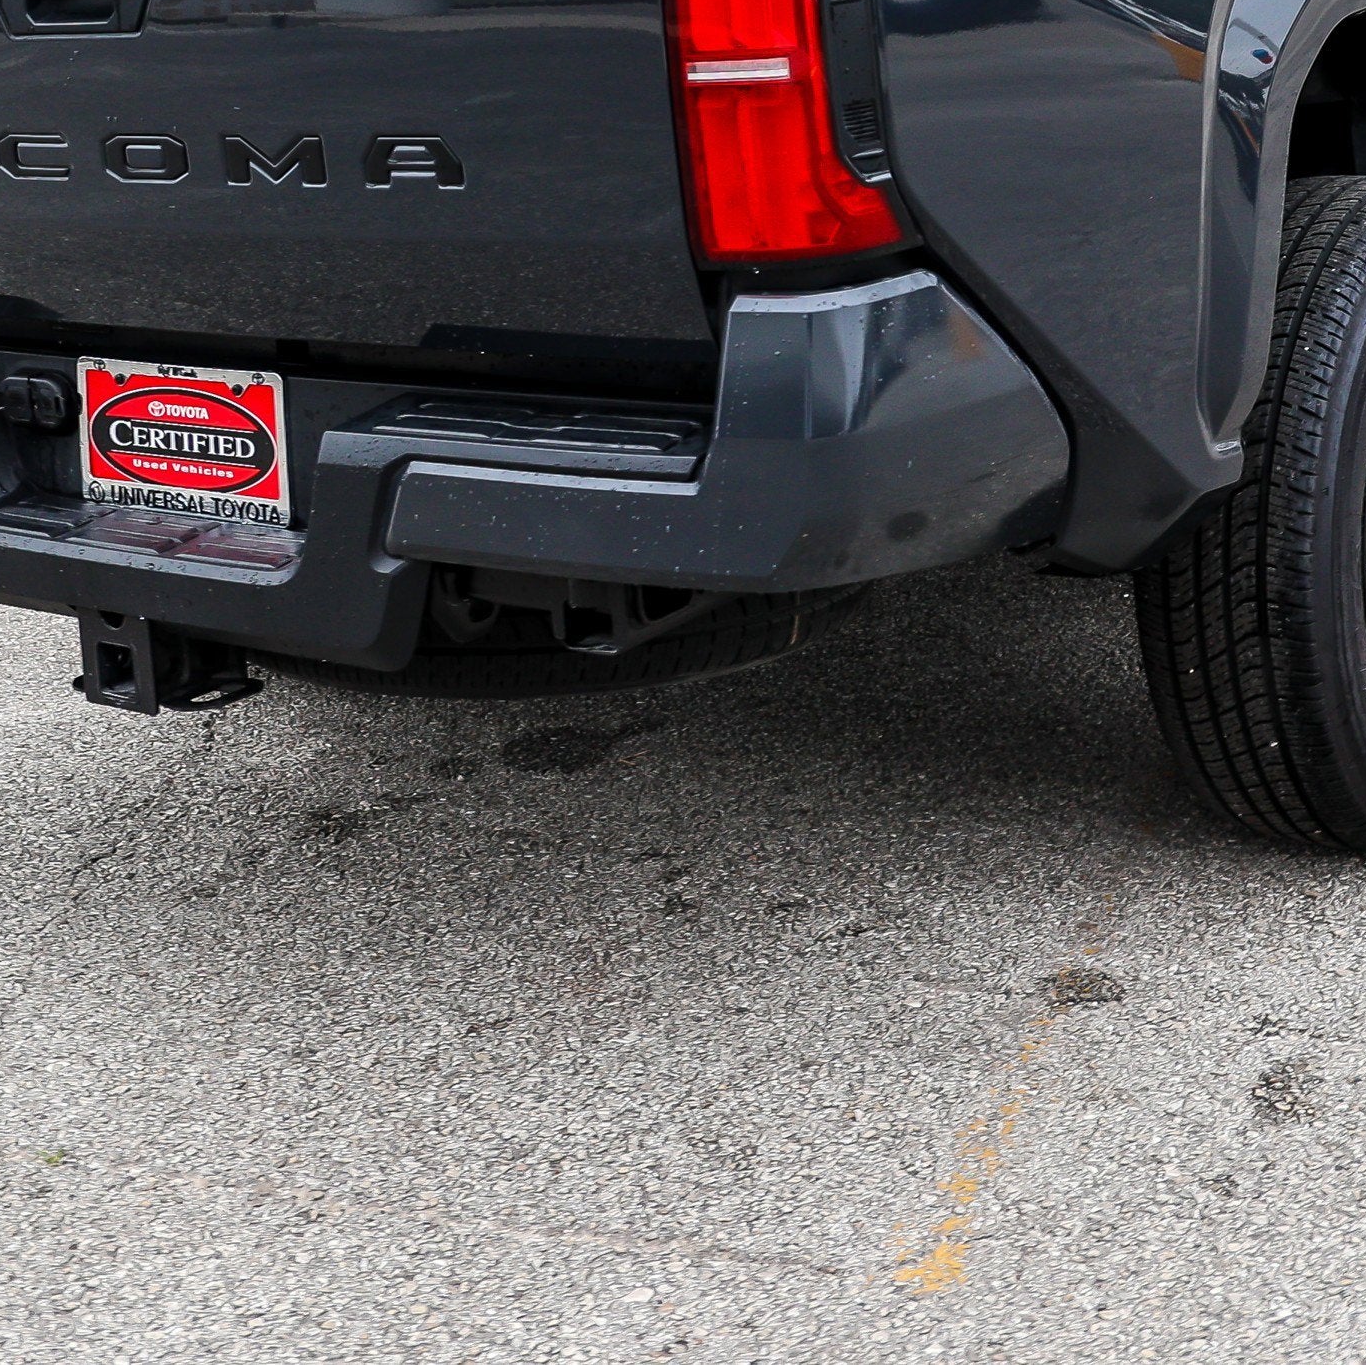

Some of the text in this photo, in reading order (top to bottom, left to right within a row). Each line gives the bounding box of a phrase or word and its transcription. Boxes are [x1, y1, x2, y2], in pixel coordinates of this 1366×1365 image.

[165, 403, 210, 420] TOYOTA
[108, 419, 256, 459] CERTIFIED
[132, 458, 234, 478] Used Vehicles
[110, 484, 282, 525] UNIVERSAL TOYOTA
